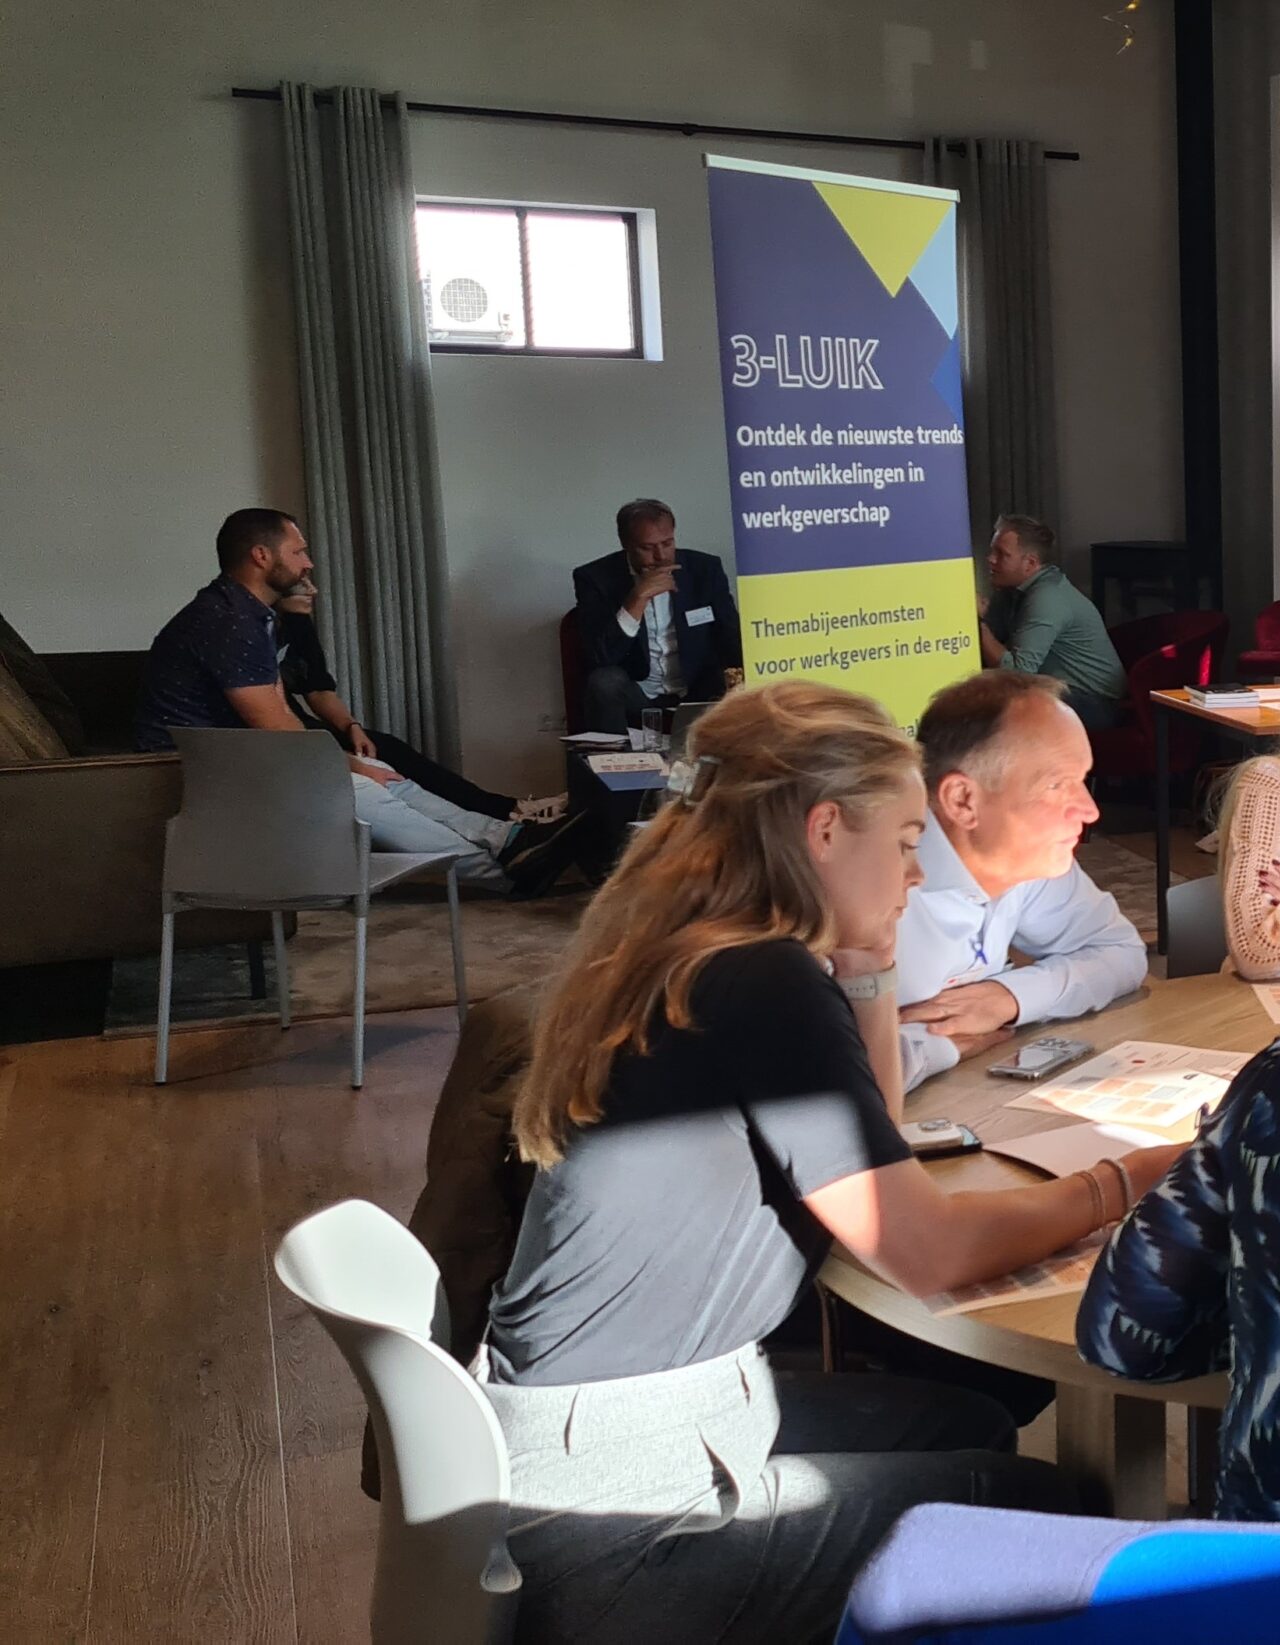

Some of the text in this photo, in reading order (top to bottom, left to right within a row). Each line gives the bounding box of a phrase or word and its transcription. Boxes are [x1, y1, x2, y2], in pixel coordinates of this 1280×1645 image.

[730, 333, 884, 390] 3-LUIK
[736, 424, 964, 447] Ontdek de nieuwste trends
[739, 461, 925, 490] en ontwikkelingen in
[742, 501, 891, 533] werkgeverschap
[751, 605, 926, 639] Themabijeenkomsten
[754, 631, 971, 676] voor werkgevers in de regio
